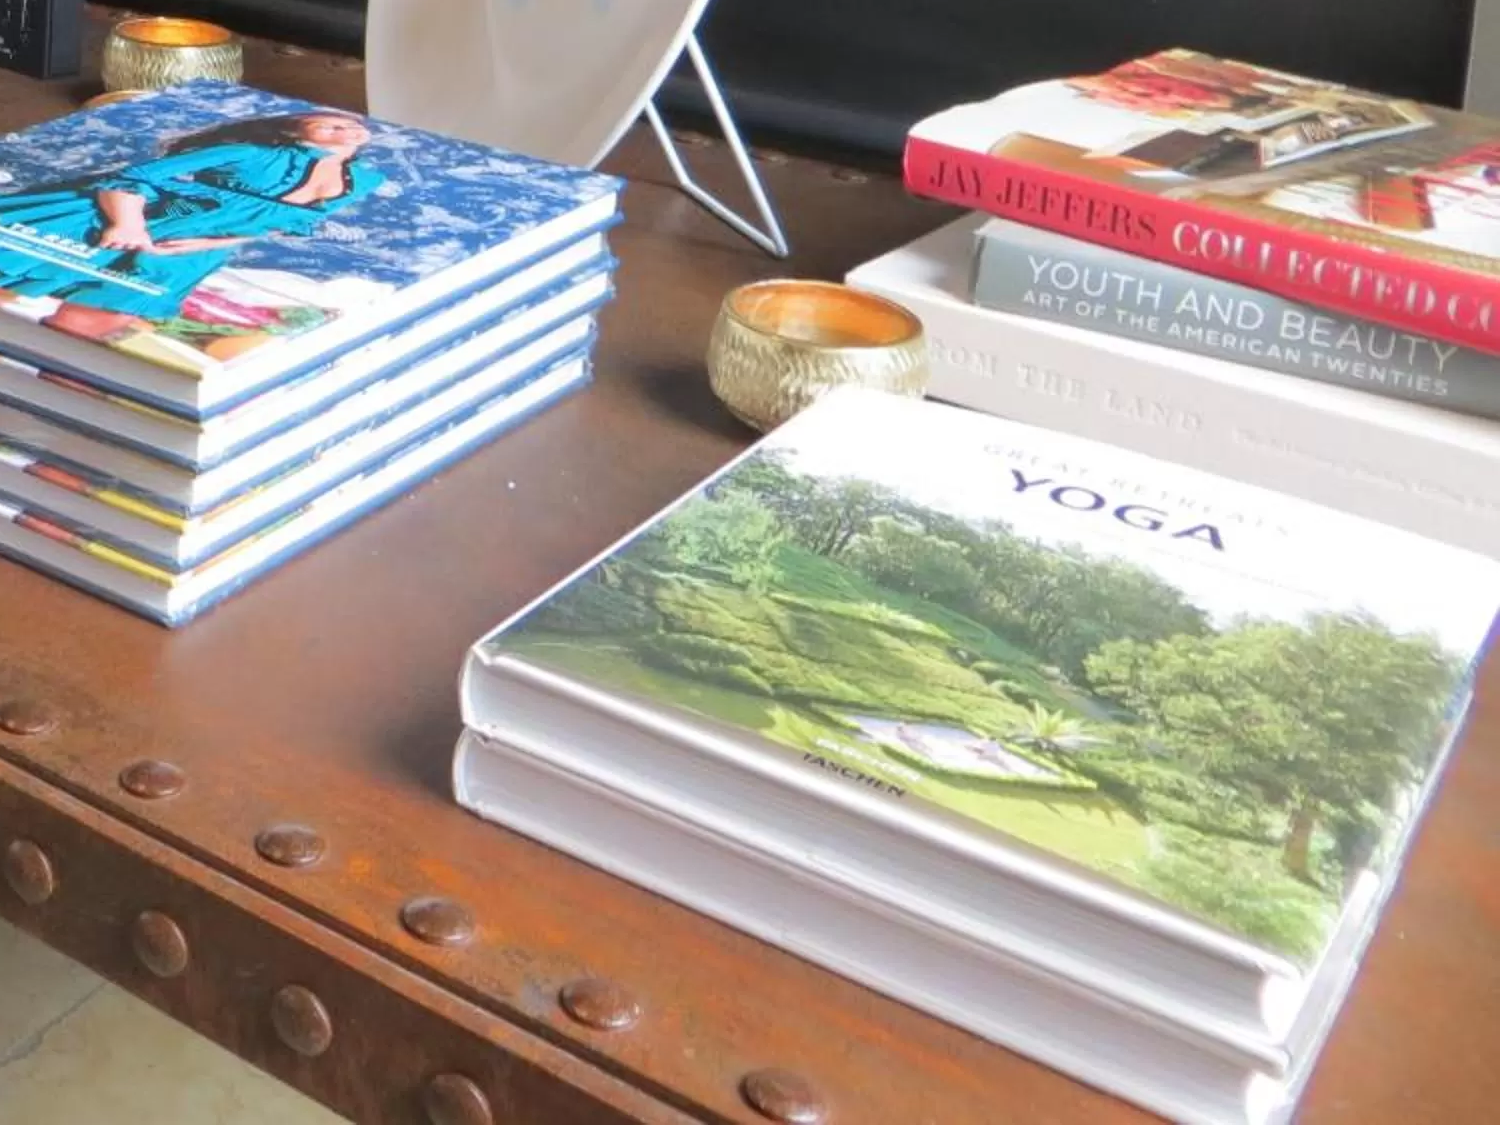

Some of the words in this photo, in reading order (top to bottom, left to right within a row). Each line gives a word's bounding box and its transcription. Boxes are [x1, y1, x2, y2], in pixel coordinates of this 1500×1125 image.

[927, 157, 992, 198] JAY
[996, 176, 1158, 242] JEFFERS
[1171, 221, 1437, 317] COLLECTED
[1022, 287, 1069, 313] ART
[1074, 298, 1106, 319] OF
[1114, 308, 1161, 335] THE
[1167, 321, 1301, 365] AMERICAN
[1309, 349, 1450, 396] TWENTIES
[1026, 253, 1163, 310] YOUTH
[1174, 289, 1265, 333] AND
[1278, 309, 1460, 374] BEAUTY
[1016, 362, 1087, 403] THE
[1105, 387, 1204, 437] LAND
[1008, 467, 1226, 552] YOGA
[803, 752, 906, 798] TASCHEN
